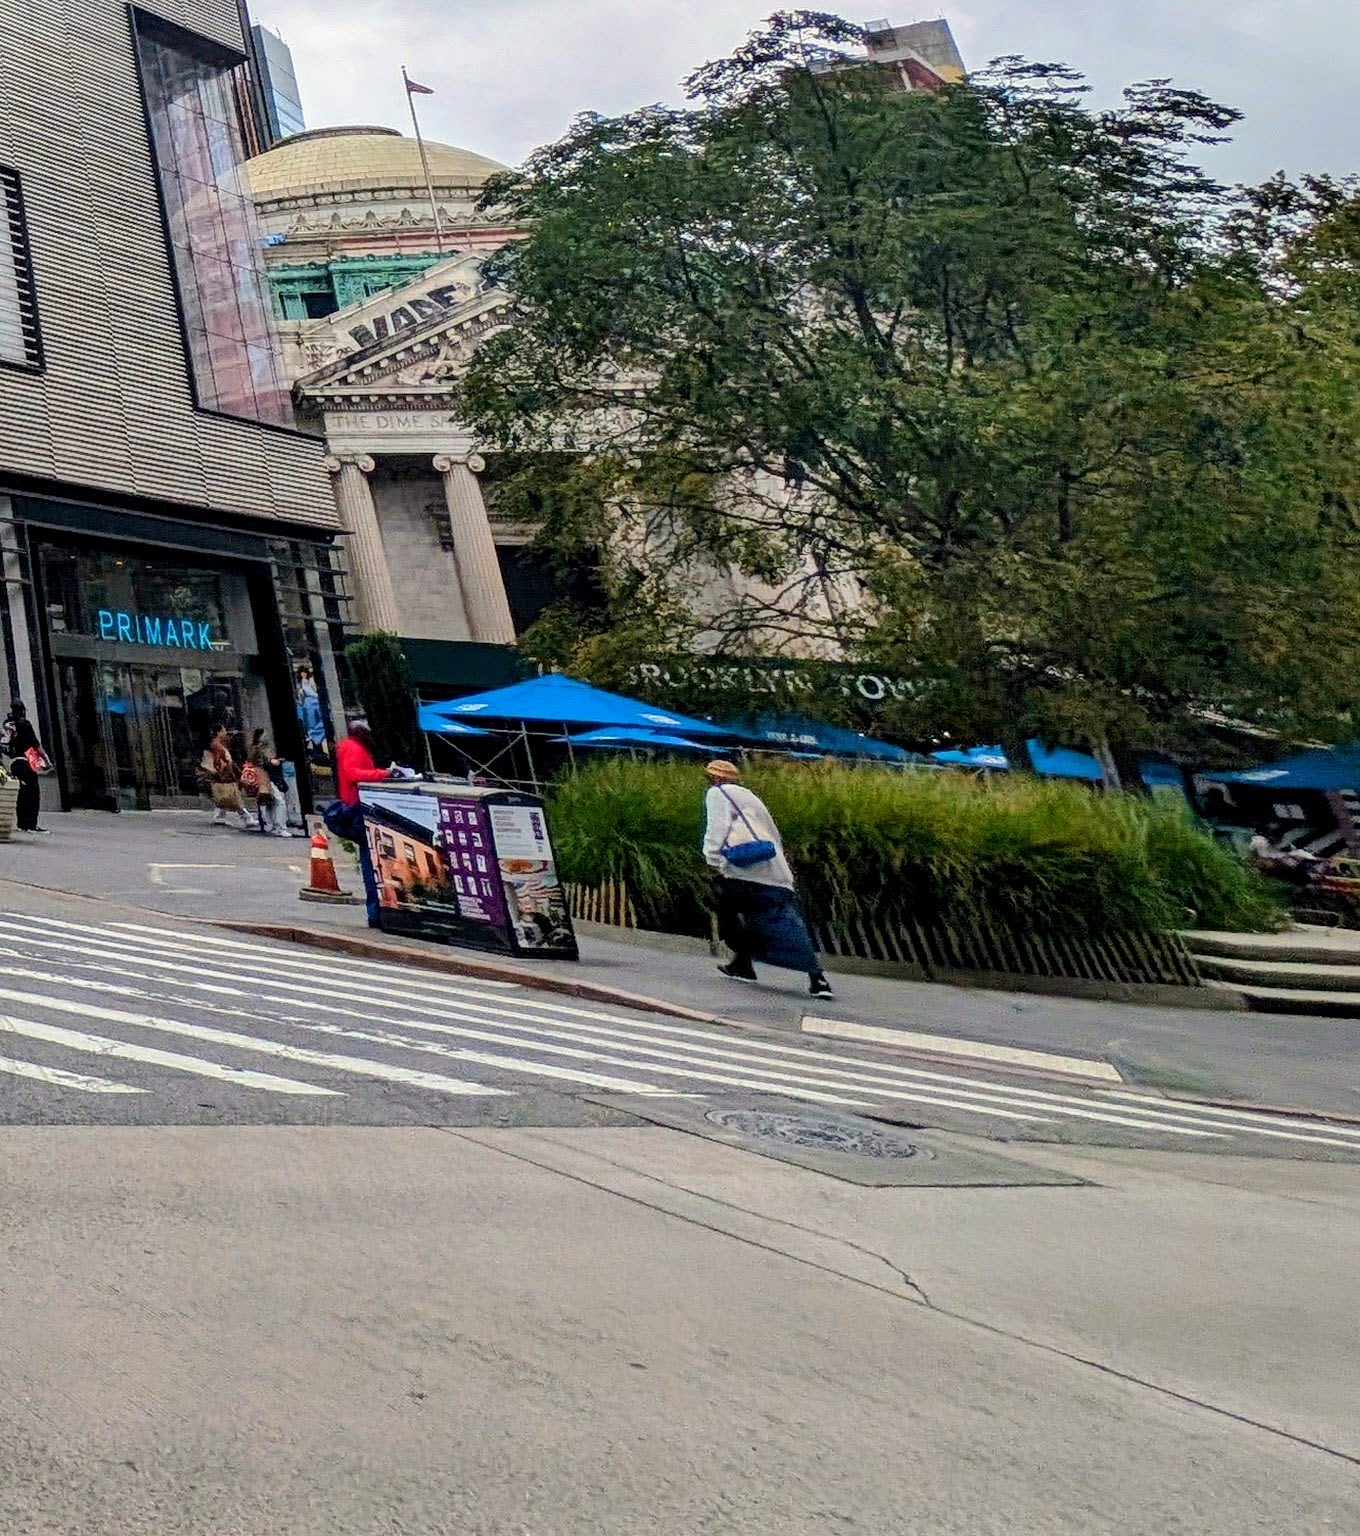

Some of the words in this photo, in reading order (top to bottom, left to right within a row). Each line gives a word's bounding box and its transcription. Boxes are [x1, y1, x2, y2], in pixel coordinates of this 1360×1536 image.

[335, 415, 371, 429] THE
[376, 415, 424, 429] DIME
[98, 610, 215, 651] PRIMARK
